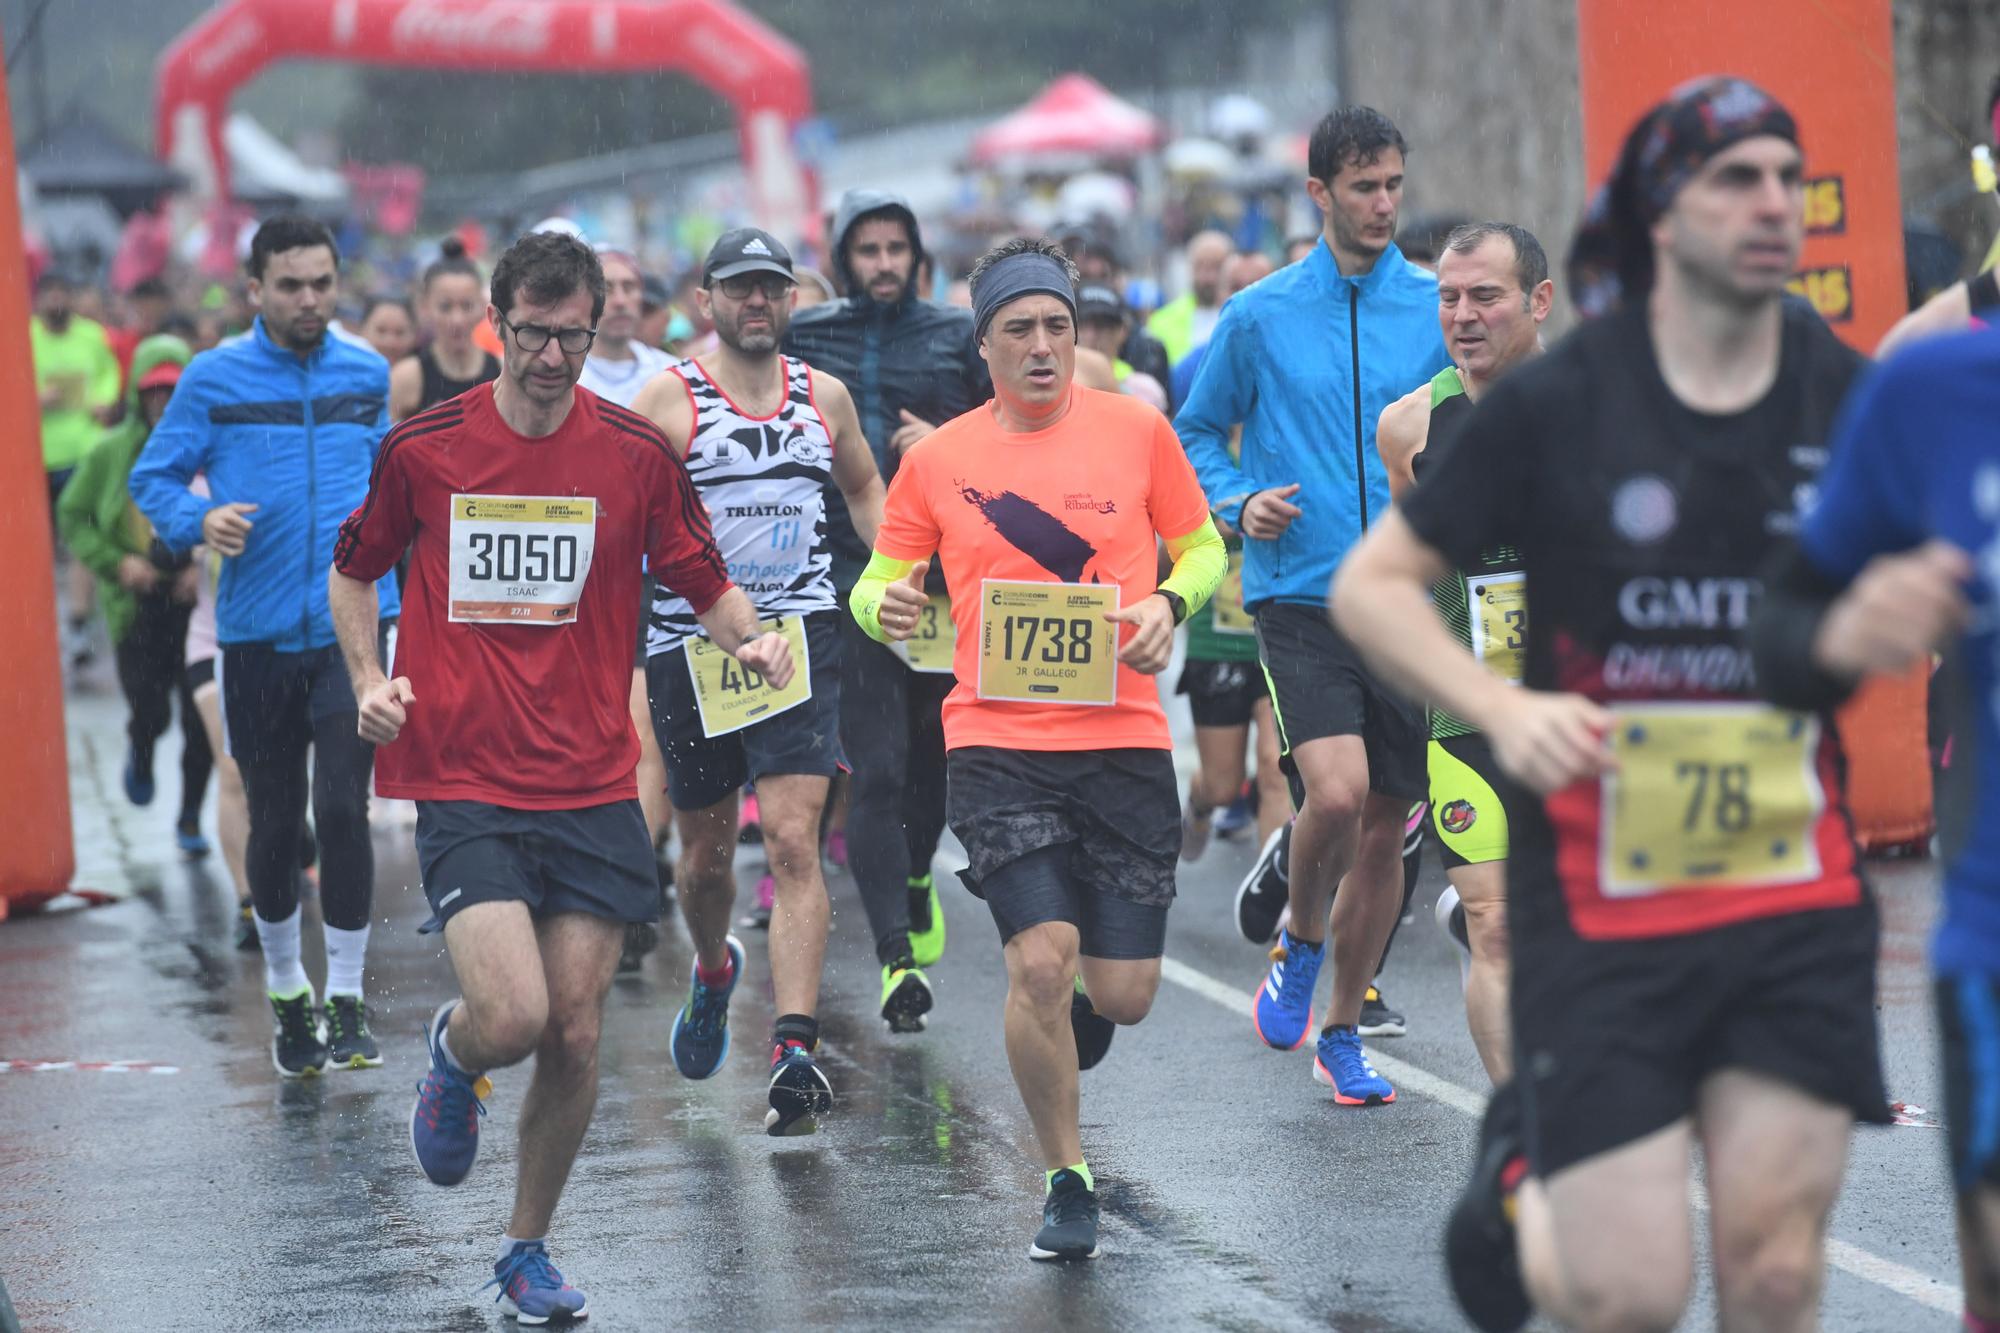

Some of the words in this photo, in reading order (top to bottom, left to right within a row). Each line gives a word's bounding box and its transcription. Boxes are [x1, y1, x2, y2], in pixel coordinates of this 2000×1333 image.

[725, 505, 803, 518] TRIATLON
[1065, 499, 1106, 511] Ribadeo
[469, 533, 577, 583] 3050
[727, 559, 800, 578] orhouse
[506, 587, 539, 597] ISAAC
[739, 582, 785, 593] TIAGO
[1617, 576, 1765, 631] GMT
[984, 620, 992, 649] TANDA
[1004, 616, 1093, 664] 1738
[1504, 609, 1526, 650] 3
[1016, 667, 1027, 676] JR
[1034, 667, 1078, 678] GALLEGO
[1674, 760, 1752, 834] 78
